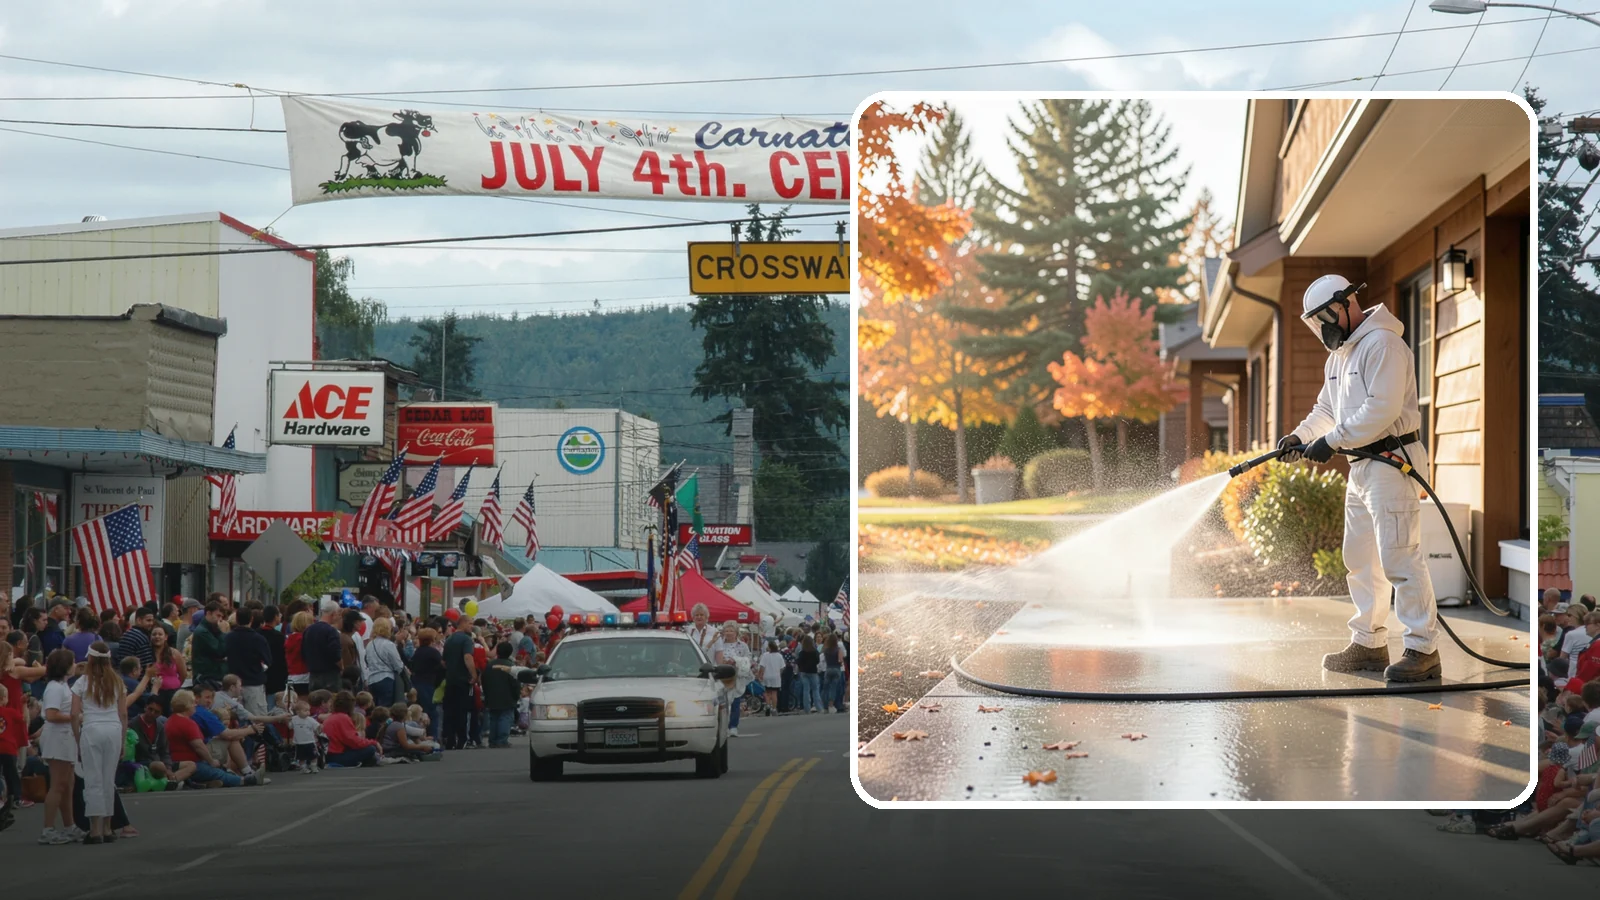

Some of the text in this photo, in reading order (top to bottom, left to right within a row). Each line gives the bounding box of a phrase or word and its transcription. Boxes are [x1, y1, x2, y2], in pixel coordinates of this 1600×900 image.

[481, 141, 605, 193] JULY
[632, 150, 746, 198] 4th.
[697, 255, 850, 280] CROSSWA
[282, 380, 373, 420] ACE
[405, 409, 485, 422] CEDAR LOG
[283, 421, 370, 436] Hardware
[416, 428, 477, 447] Coca-Cola
[83, 485, 155, 495] St. Vincent de Paul
[688, 526, 742, 535] CRNATION
[699, 535, 730, 543] GLASS
